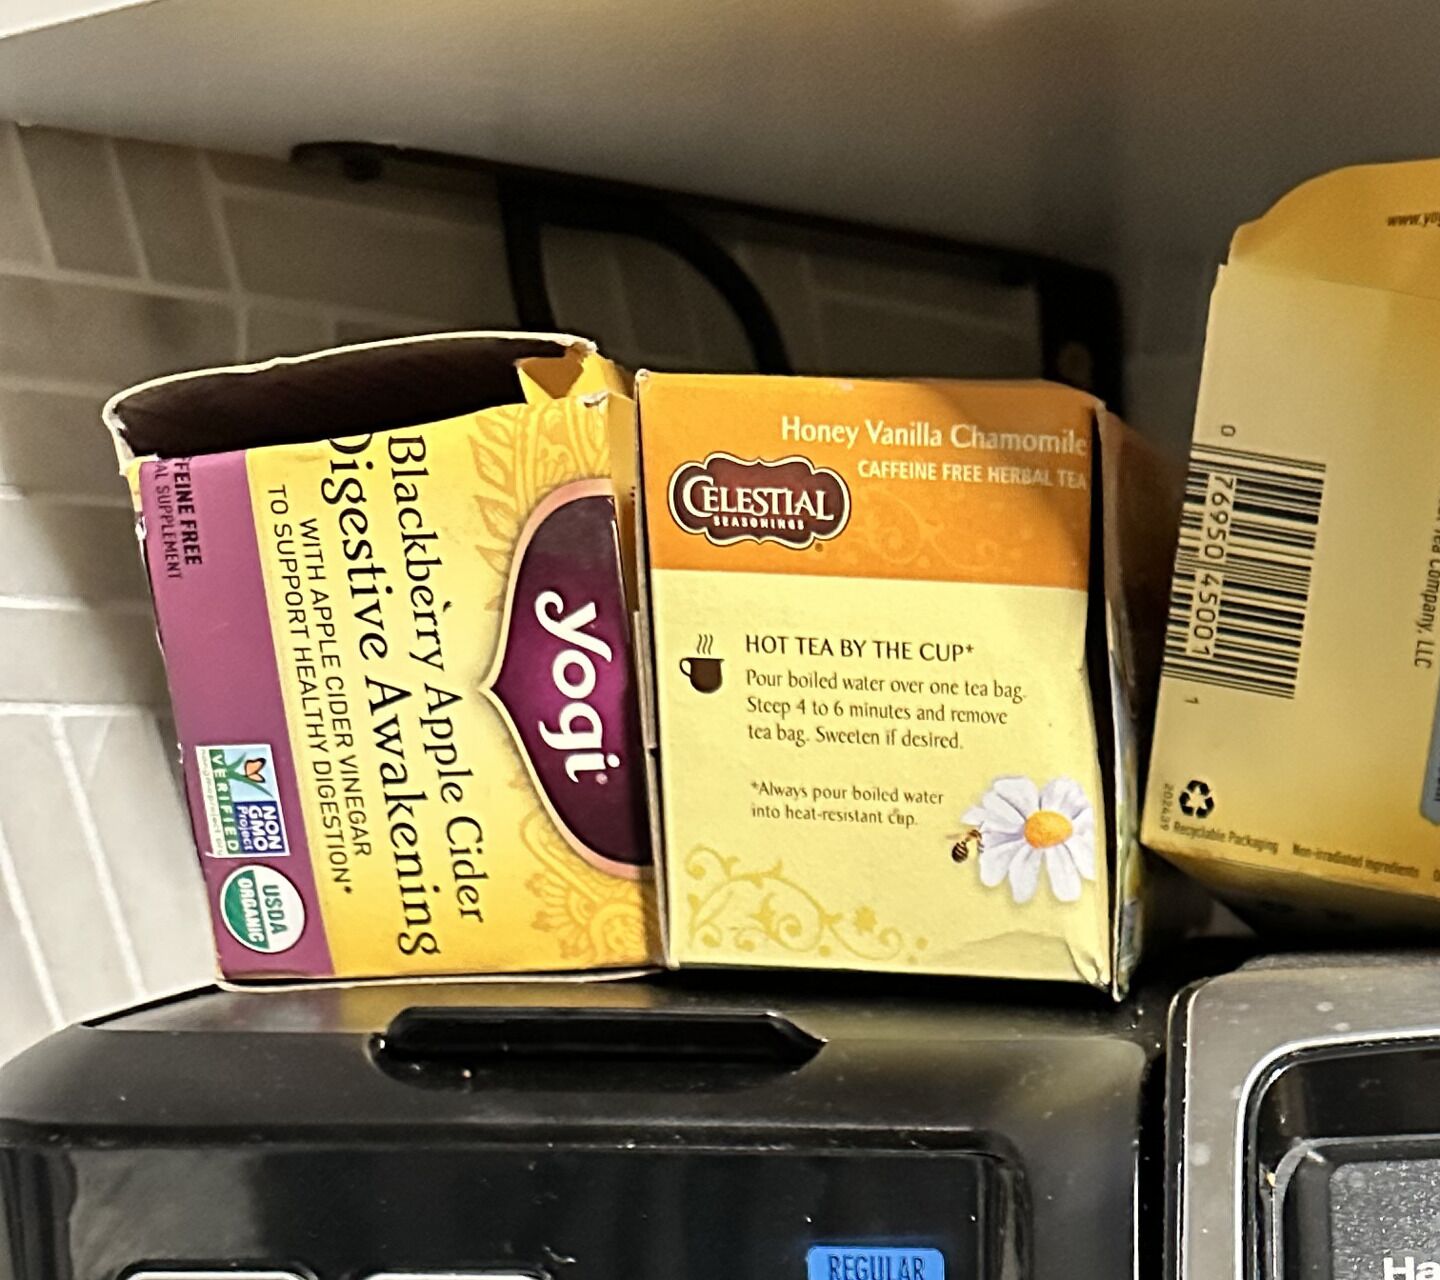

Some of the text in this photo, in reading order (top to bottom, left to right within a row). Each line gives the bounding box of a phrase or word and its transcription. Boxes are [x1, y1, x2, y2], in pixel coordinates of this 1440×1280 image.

[780, 415, 1088, 457] Honey Vanilla Chamomile
[1220, 424, 1236, 437] 0
[682, 475, 835, 521] CELESTIAL
[857, 459, 1088, 491] CAFFEINE FREE HERBAL TEA
[268, 484, 289, 515] TO
[713, 515, 805, 530] SEASONINGS
[155, 485, 182, 579] SUPPLEMENT
[180, 520, 203, 565] FREE
[274, 524, 310, 640] SUPPORT
[1191, 475, 1235, 657] 76950 45001
[745, 634, 790, 655] HOT
[795, 636, 835, 657] TEA
[840, 639, 867, 659] BY
[872, 640, 914, 661] THE
[1414, 640, 1436, 669] LLC
[293, 647, 329, 753] HEALTHY
[299, 518, 372, 857] WITH APPLE CIDER VINEGAR
[387, 435, 490, 924] Blackberry Apple Cider
[534, 590, 621, 783] yogi
[746, 669, 1027, 704] Pour boiled water over one tea bag.
[748, 697, 1008, 725] Steep 4 to 6 minutes and remove
[748, 724, 963, 749] tea bag. Sweeten if desired.
[211, 753, 240, 852] VERIFIED
[364, 675, 442, 956] Awakening
[752, 804, 918, 829] into heat-resistant cup.
[812, 786, 848, 805] pour
[852, 785, 899, 802] boiled
[904, 788, 944, 804] water
[236, 805, 254, 851] Project
[249, 806, 269, 852] GMO
[262, 804, 284, 851] NON
[1228, 830, 1279, 855] Packaging
[237, 876, 265, 944] ORGANIC
[262, 884, 289, 935] USDA
